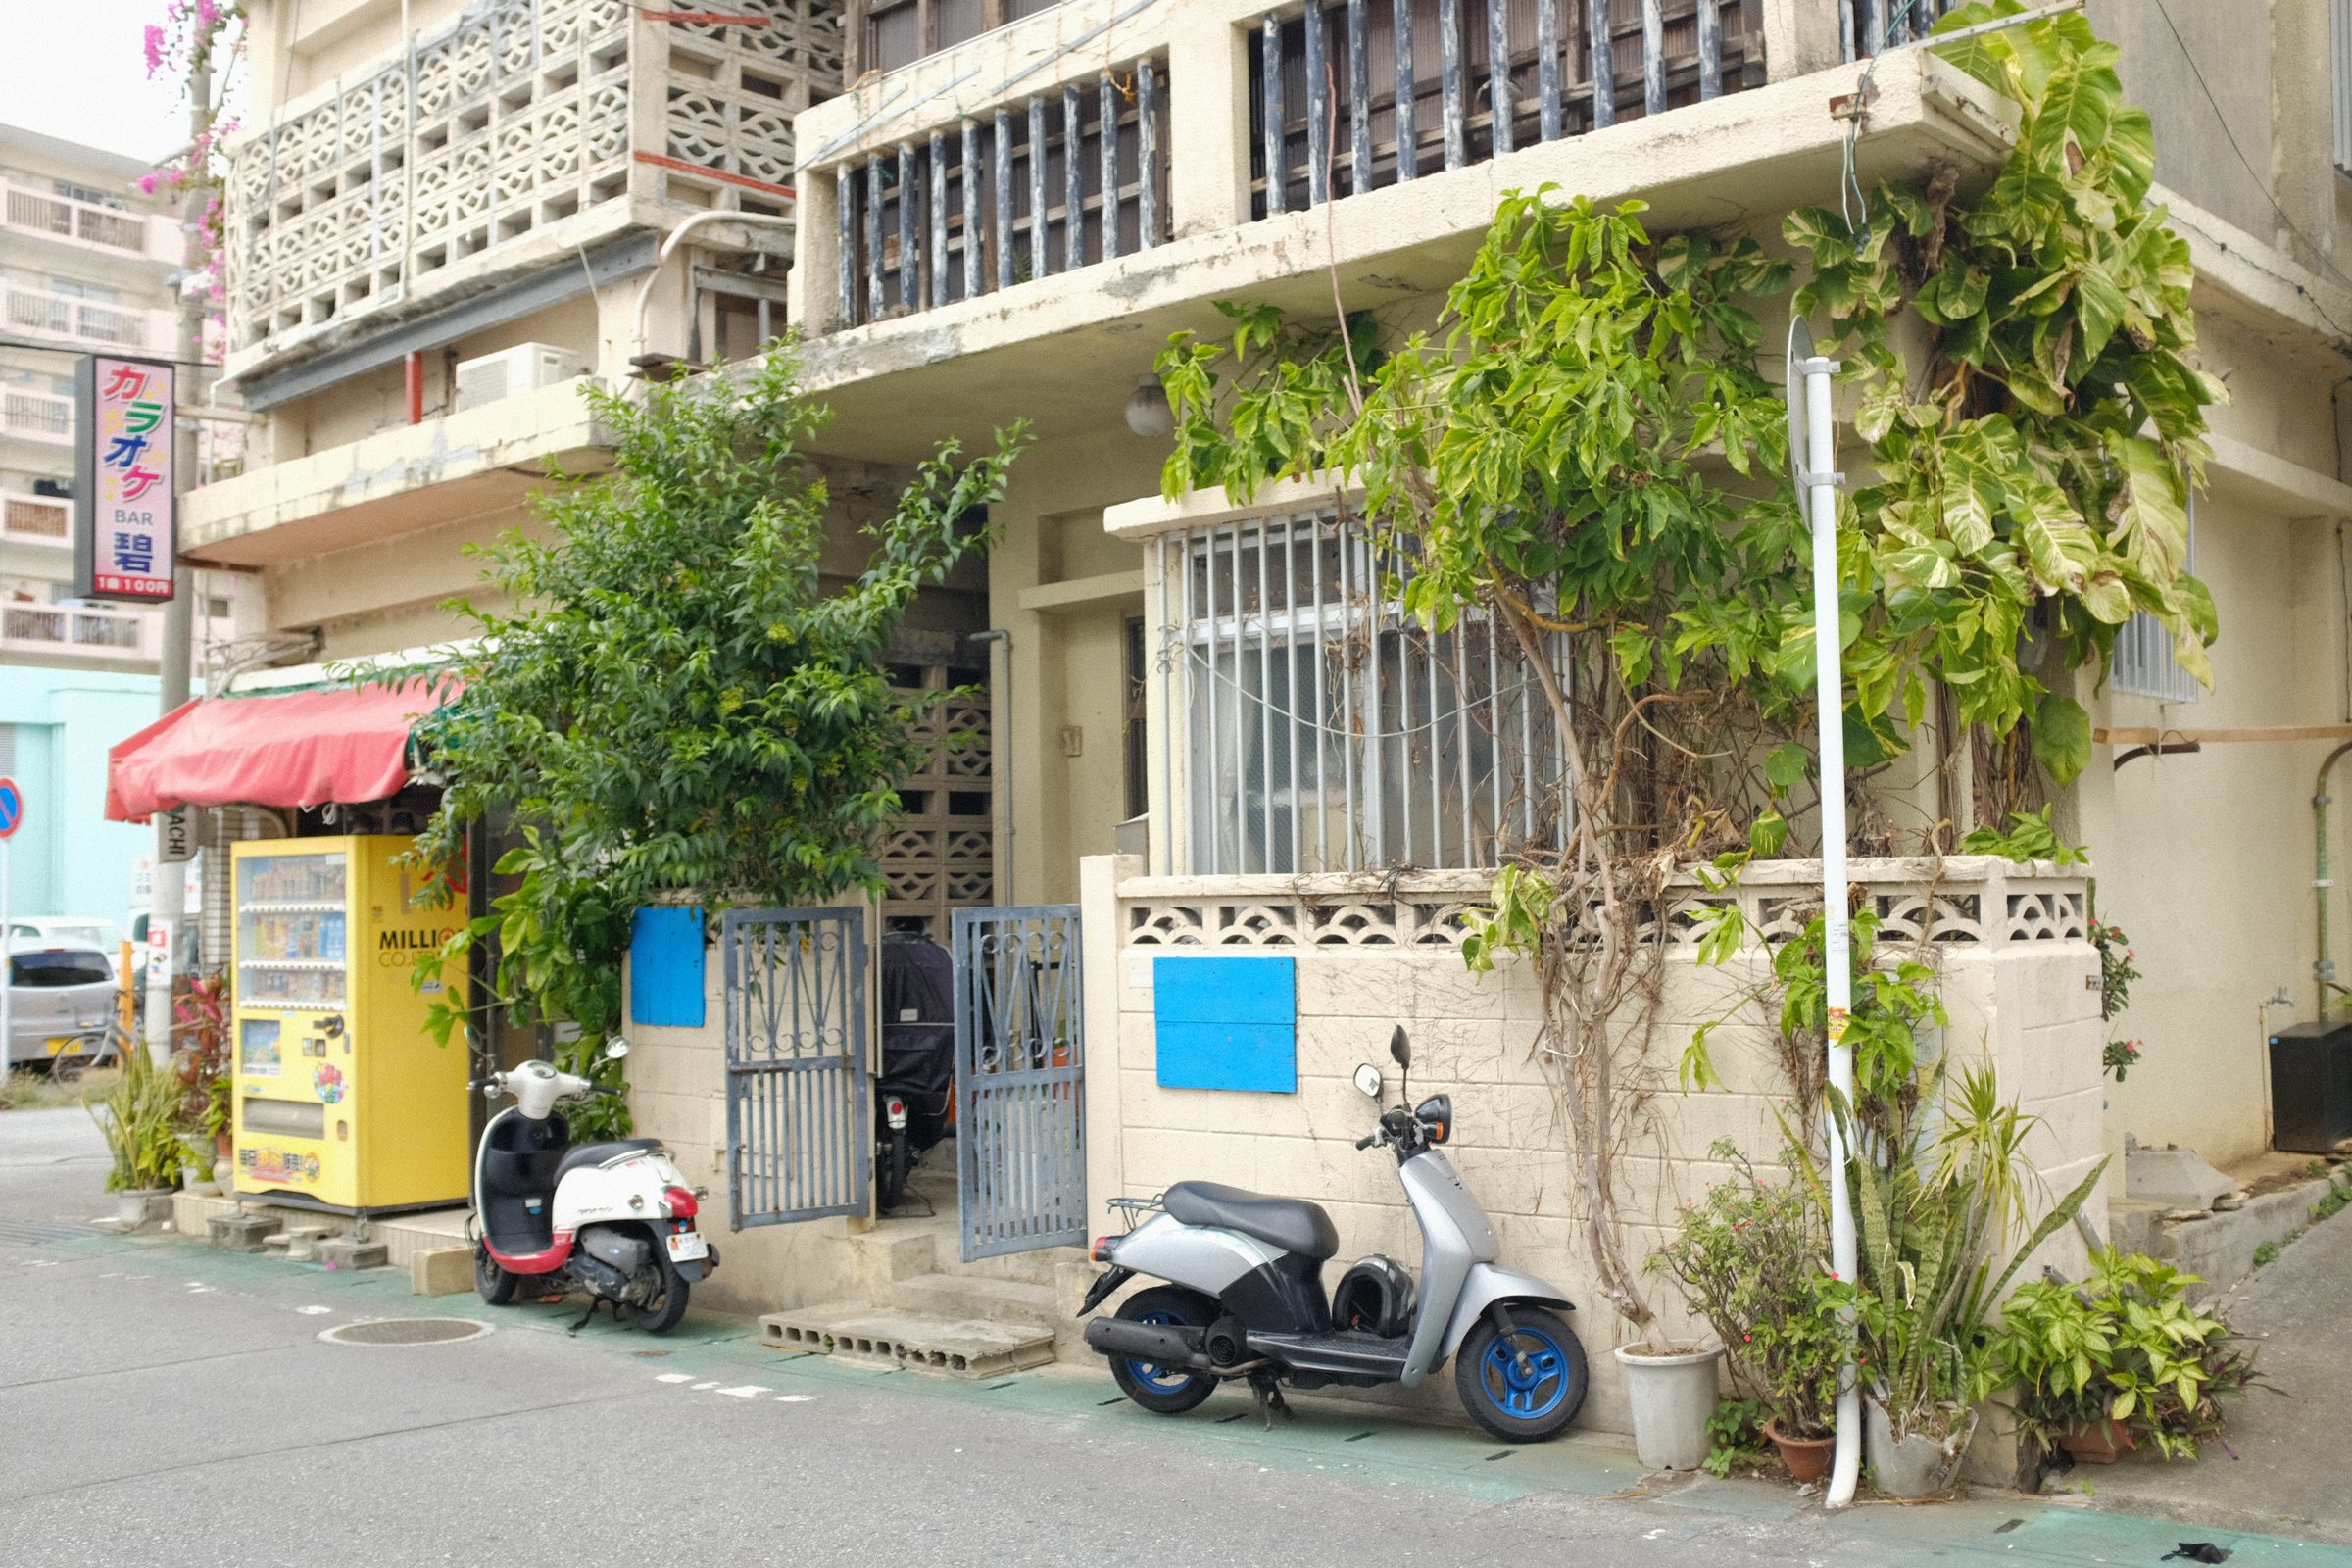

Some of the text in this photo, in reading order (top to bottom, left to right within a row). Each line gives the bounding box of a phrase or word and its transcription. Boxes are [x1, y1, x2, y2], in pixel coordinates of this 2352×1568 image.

[102, 363, 165, 502] カラオケ
[114, 509, 154, 526] BAR
[114, 532, 153, 573] 碧
[378, 927, 464, 951] MILLIO
